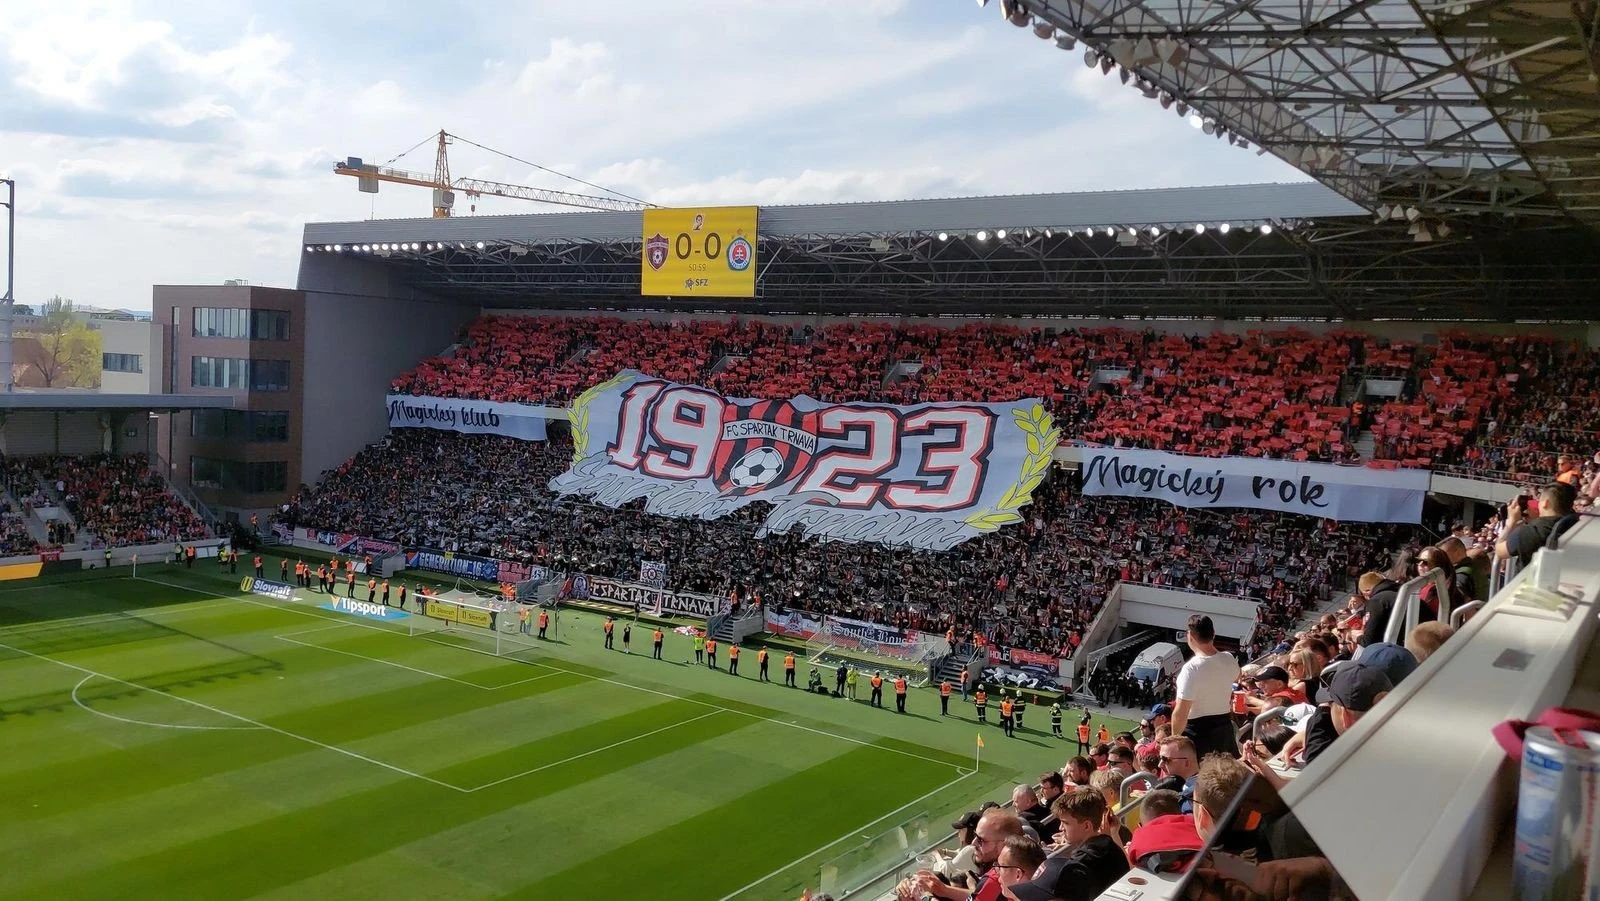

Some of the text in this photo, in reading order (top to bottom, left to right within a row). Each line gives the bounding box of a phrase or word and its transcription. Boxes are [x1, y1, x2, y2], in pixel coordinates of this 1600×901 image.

[695, 278, 709, 287] SFZ
[387, 399, 500, 427] Magický klub
[726, 422, 816, 455] FC SPARTAK TRNAVA
[1082, 455, 1329, 508] Magický rok
[253, 580, 292, 596] Slovnaft
[341, 597, 387, 616] Tipsport
[663, 595, 713, 616] TRNAVA
